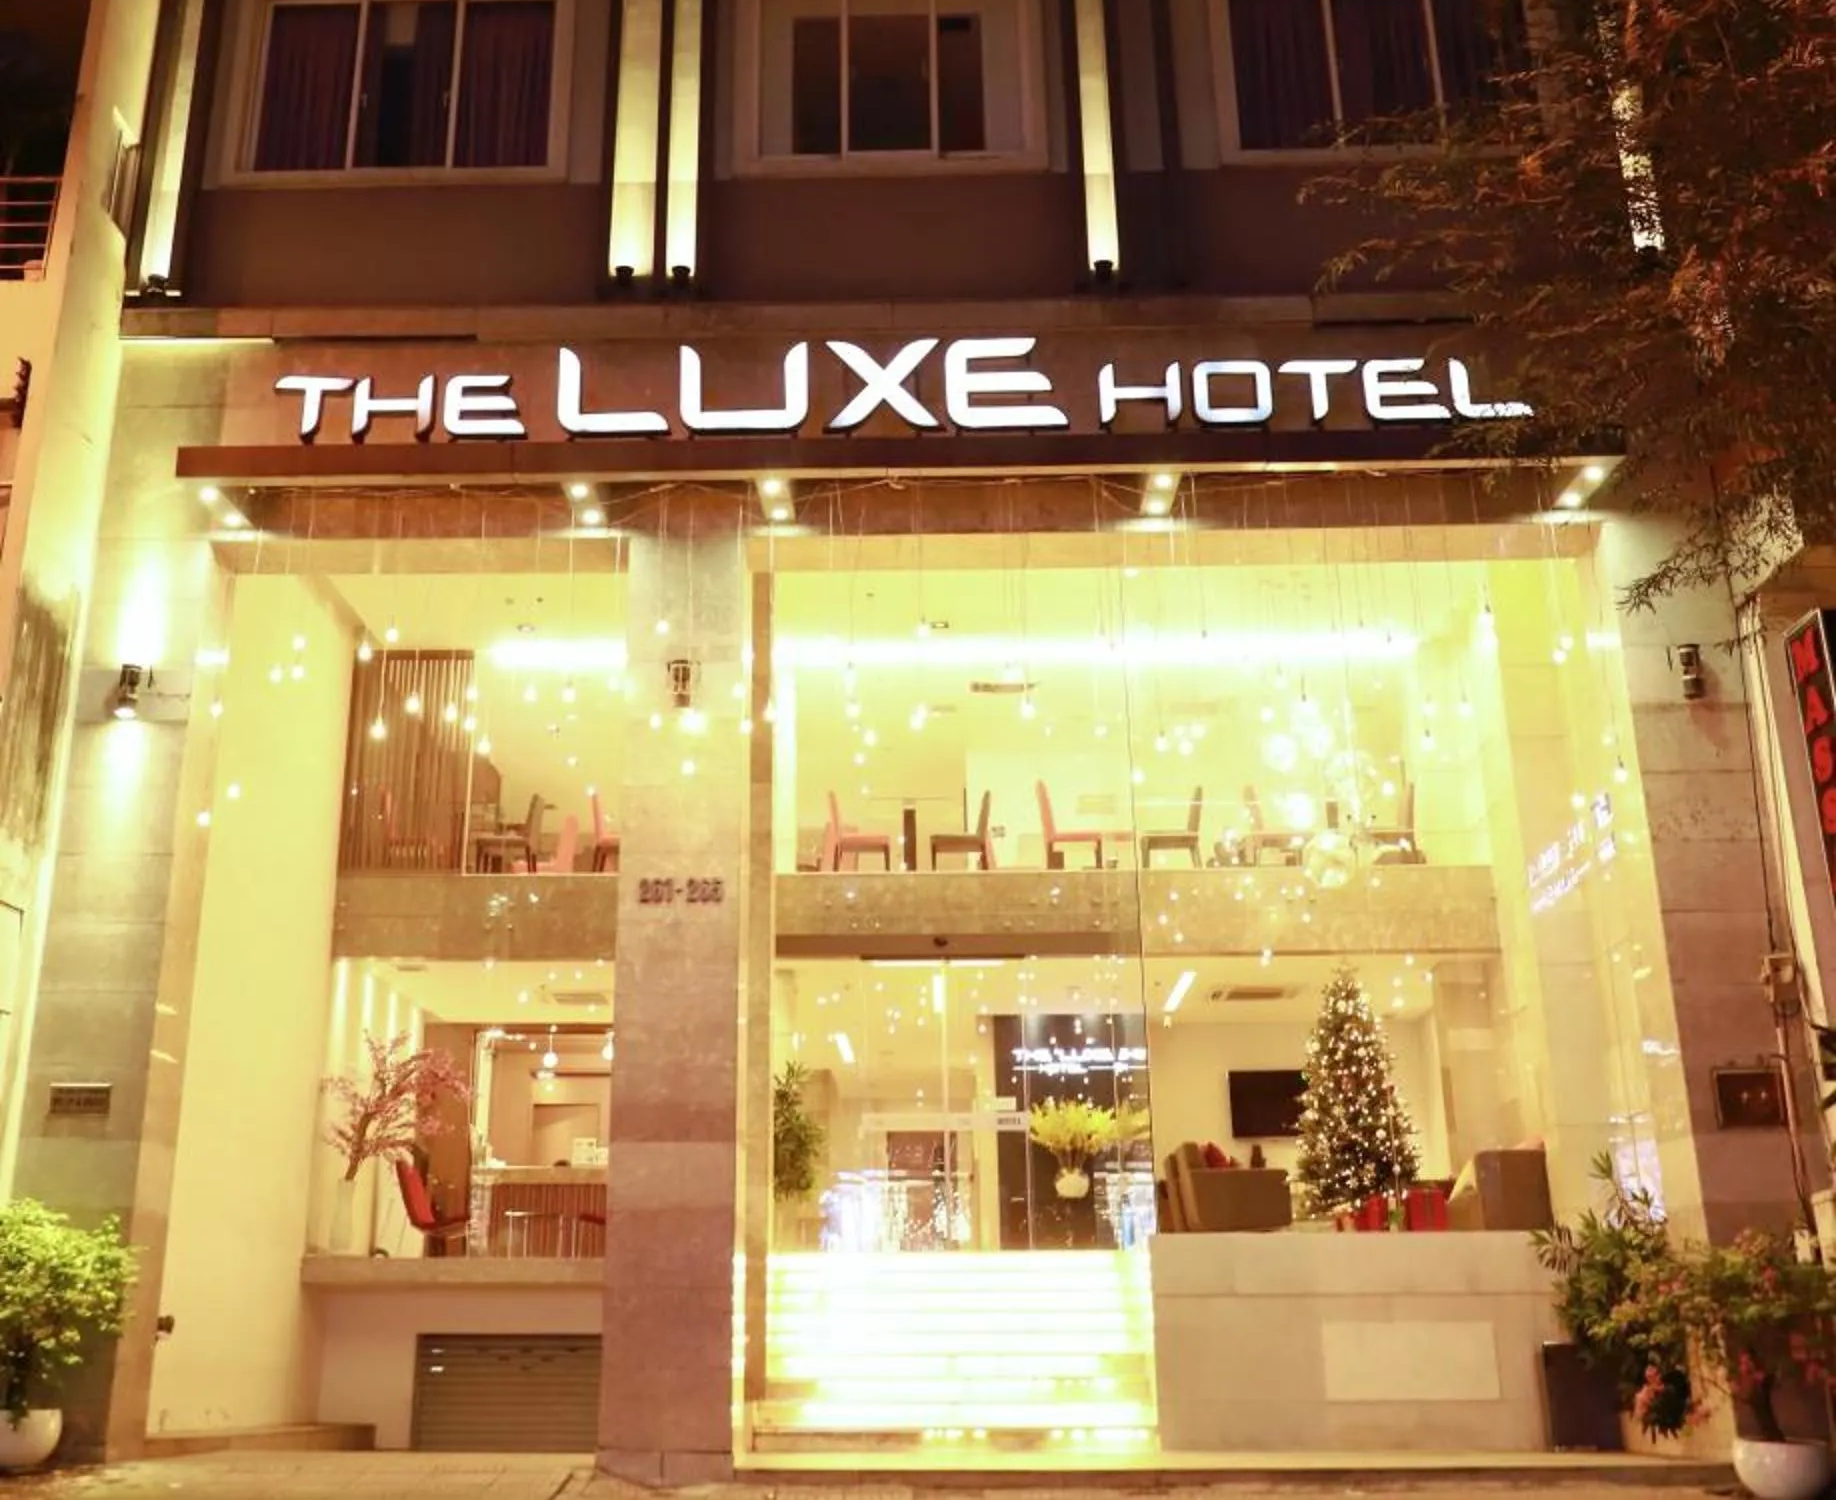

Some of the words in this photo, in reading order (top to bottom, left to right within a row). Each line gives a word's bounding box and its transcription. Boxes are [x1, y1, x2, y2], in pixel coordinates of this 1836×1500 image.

[275, 374, 527, 438] THE
[556, 337, 1069, 434] LUXE
[1098, 357, 1535, 424] HOTEL
